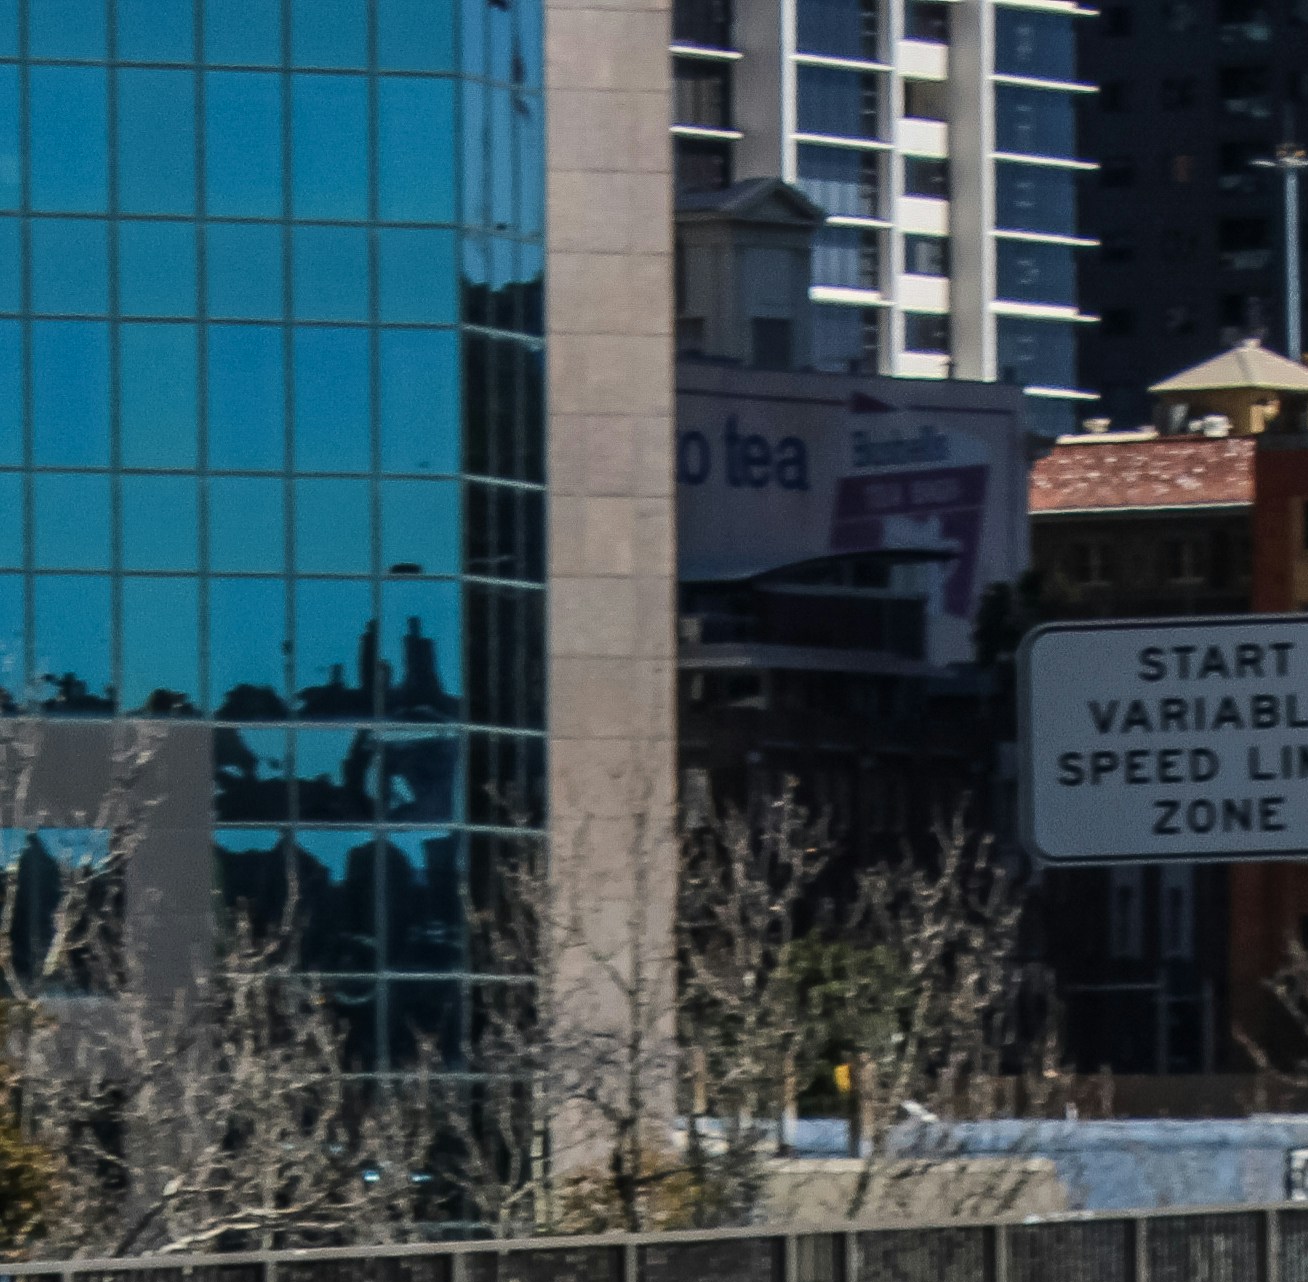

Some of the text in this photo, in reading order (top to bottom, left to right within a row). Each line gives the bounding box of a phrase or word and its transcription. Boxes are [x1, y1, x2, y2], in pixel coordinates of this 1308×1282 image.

[723, 415, 809, 491] tea
[1138, 641, 1295, 682] START
[1057, 747, 1220, 787] SPEED
[1152, 797, 1287, 835] ZONE
